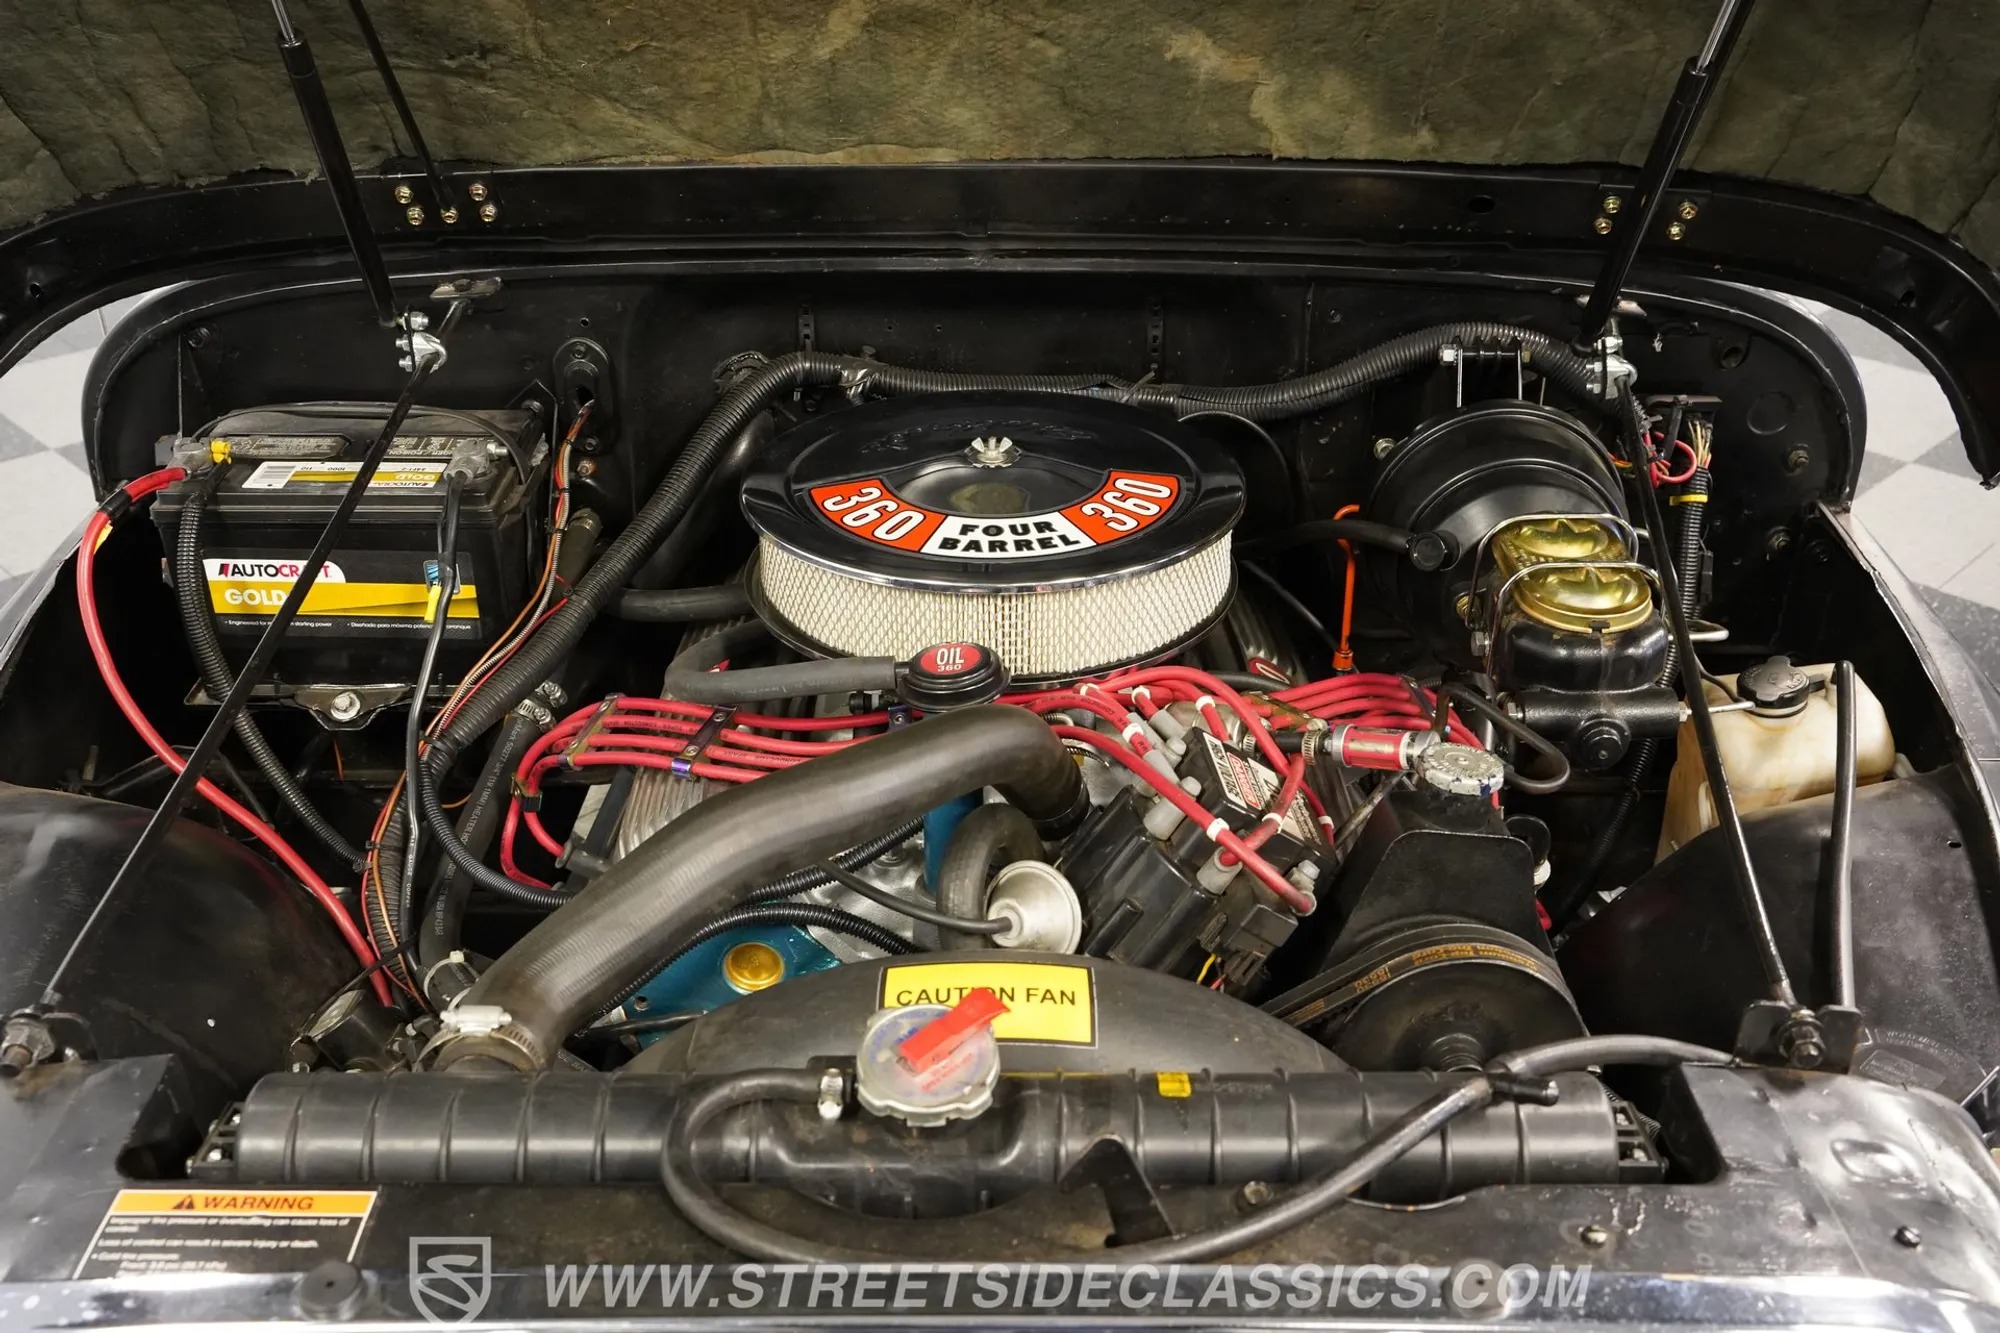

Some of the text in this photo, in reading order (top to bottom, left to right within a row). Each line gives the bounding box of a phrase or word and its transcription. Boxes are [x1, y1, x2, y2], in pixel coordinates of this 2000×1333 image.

[822, 486, 927, 541] 360
[1081, 477, 1173, 533] 360
[958, 521, 1057, 538] FOUR
[938, 534, 1082, 553] BARREL
[231, 563, 330, 578] AUTOCRT
[224, 588, 290, 606] GOLD
[936, 647, 965, 665] OIL
[937, 664, 962, 672] 360
[1233, 760, 1260, 807] DANGER
[896, 986, 1076, 1006] CAUTN FAN
[203, 1195, 315, 1210] WARNING
